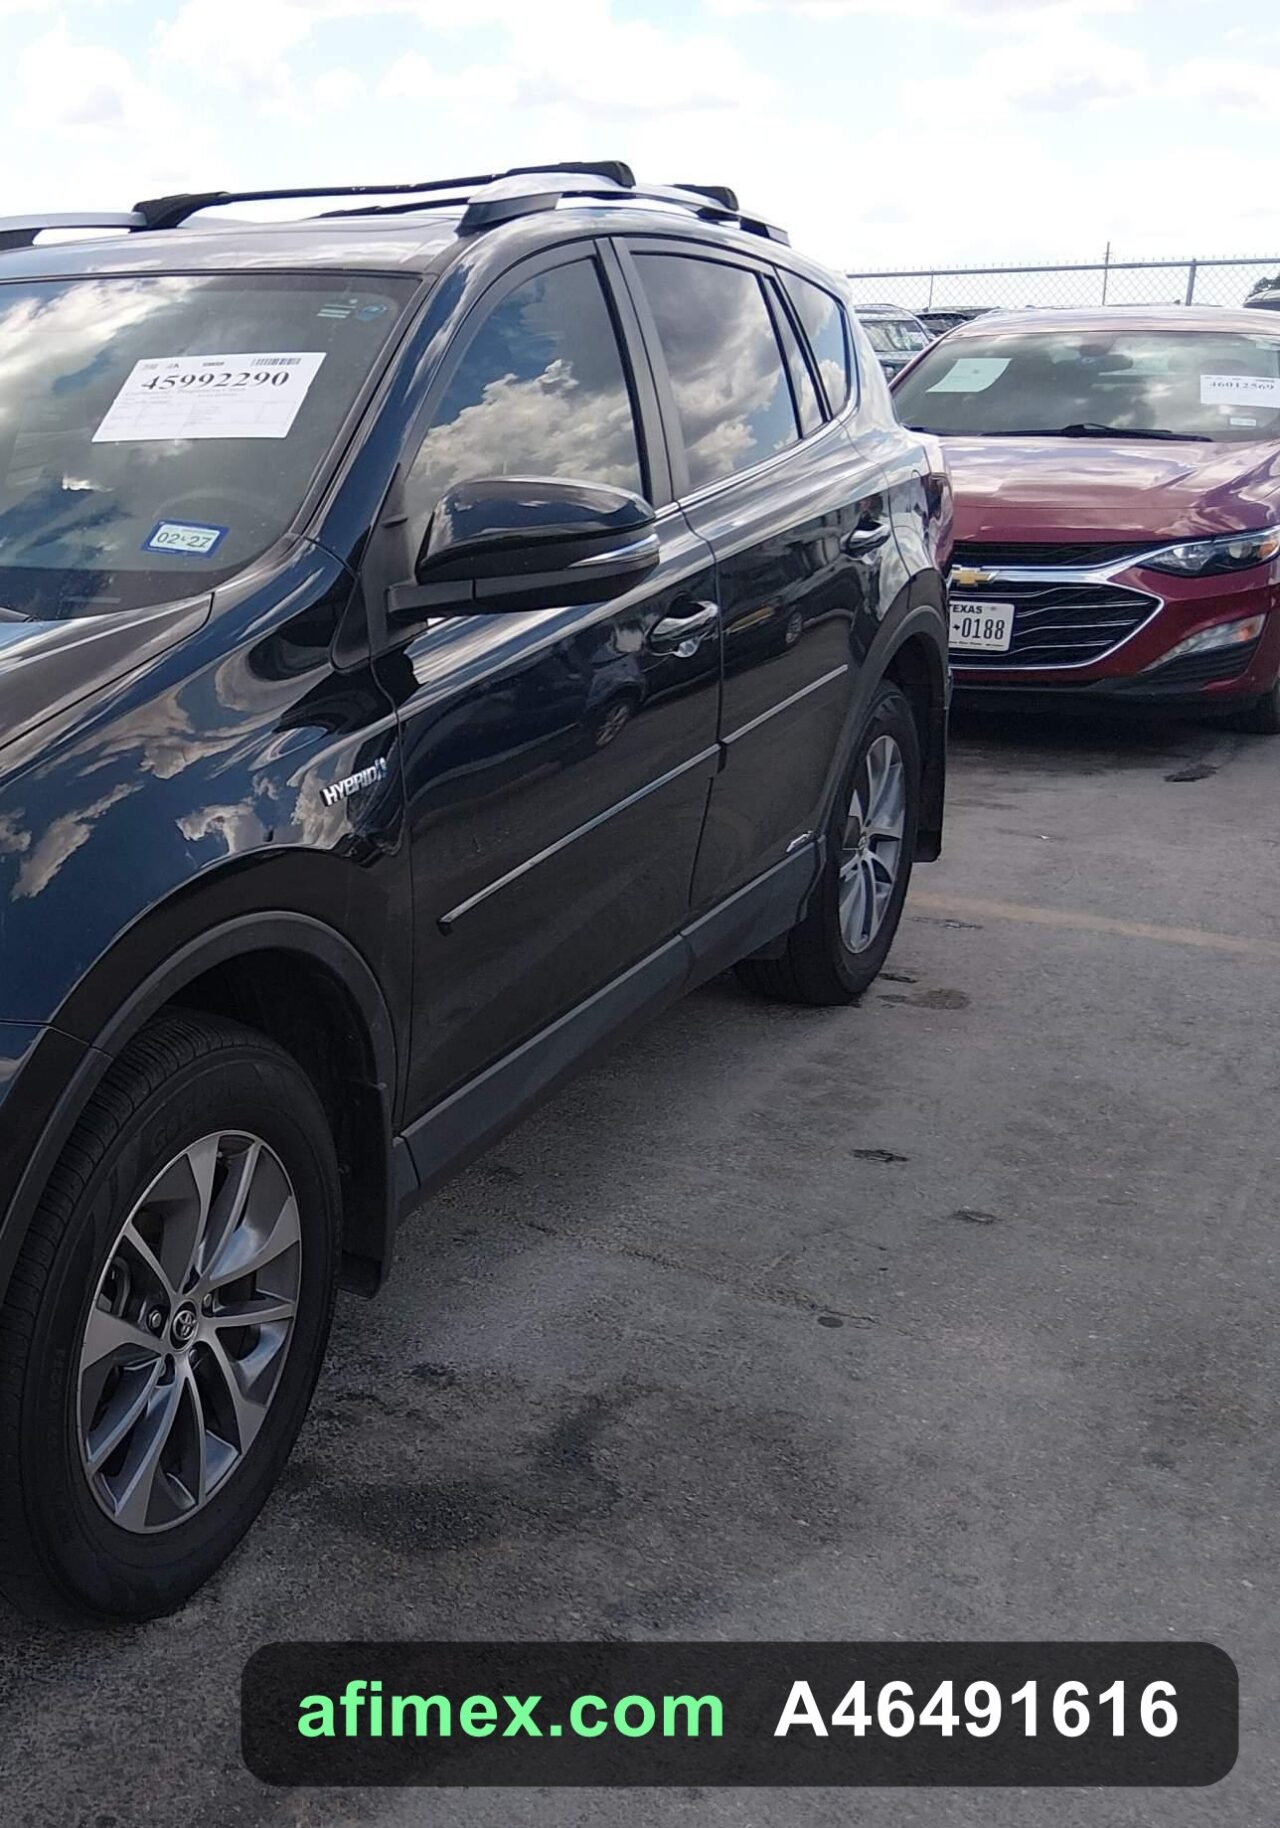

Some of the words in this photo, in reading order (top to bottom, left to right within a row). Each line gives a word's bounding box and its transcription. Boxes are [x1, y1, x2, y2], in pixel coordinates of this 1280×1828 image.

[141, 371, 290, 391] 45992290
[961, 617, 1005, 640] 0188
[321, 765, 378, 806] HYBRID
